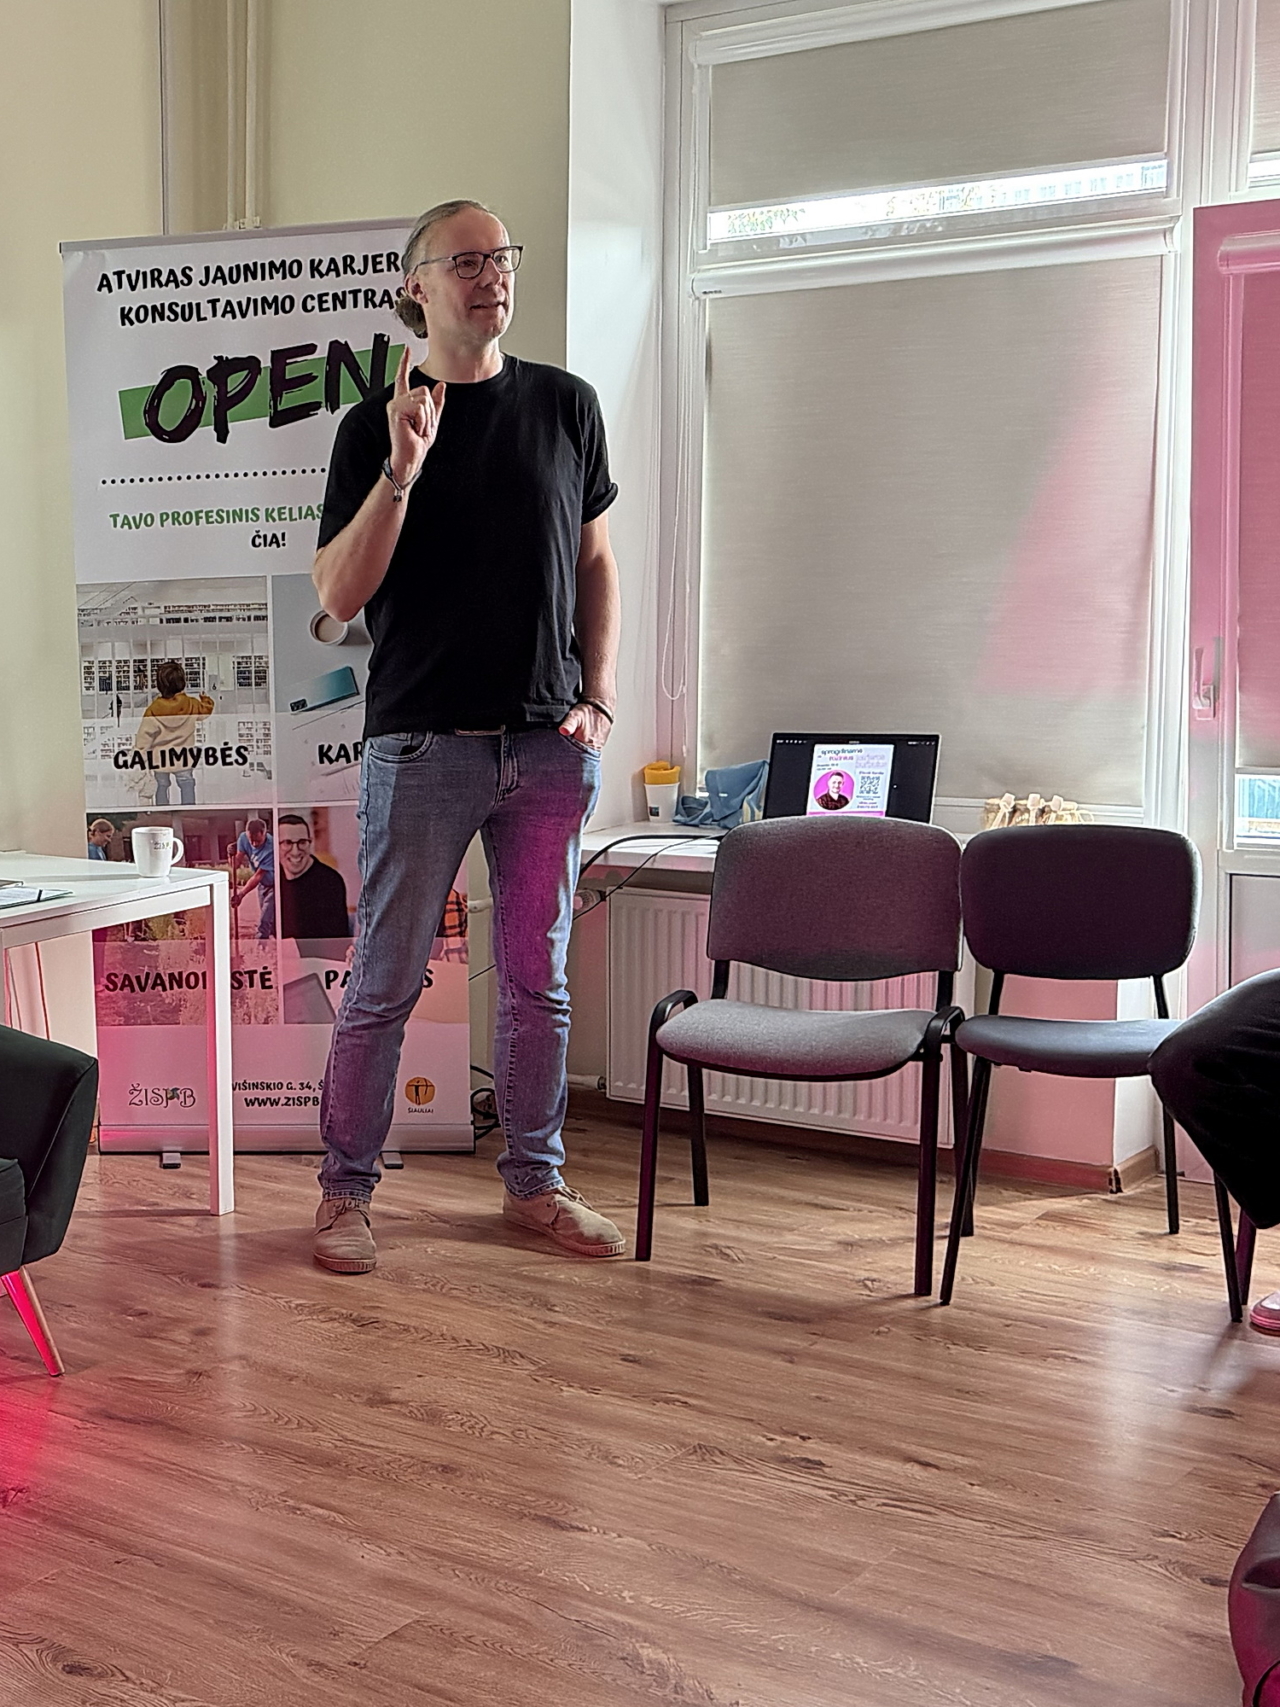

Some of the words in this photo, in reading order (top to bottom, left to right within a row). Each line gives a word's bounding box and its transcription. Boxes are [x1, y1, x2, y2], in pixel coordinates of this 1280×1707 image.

[97, 265, 194, 295] ATVIRAS
[198, 258, 303, 288] JAUNIMO
[309, 251, 401, 280] KARJER
[119, 294, 295, 327] KONSULTAVIMO
[143, 332, 391, 445] OPEN
[109, 512, 155, 530] TAVO
[159, 506, 260, 528] PROFESINIS
[250, 529, 287, 549] ČIA!
[113, 741, 249, 771] GALIMYBĖS
[318, 741, 363, 765] KAR
[286, 1081, 296, 1091] G.
[298, 1081, 316, 1093] 34,
[244, 1096, 320, 1108] WWW.ZISPB
